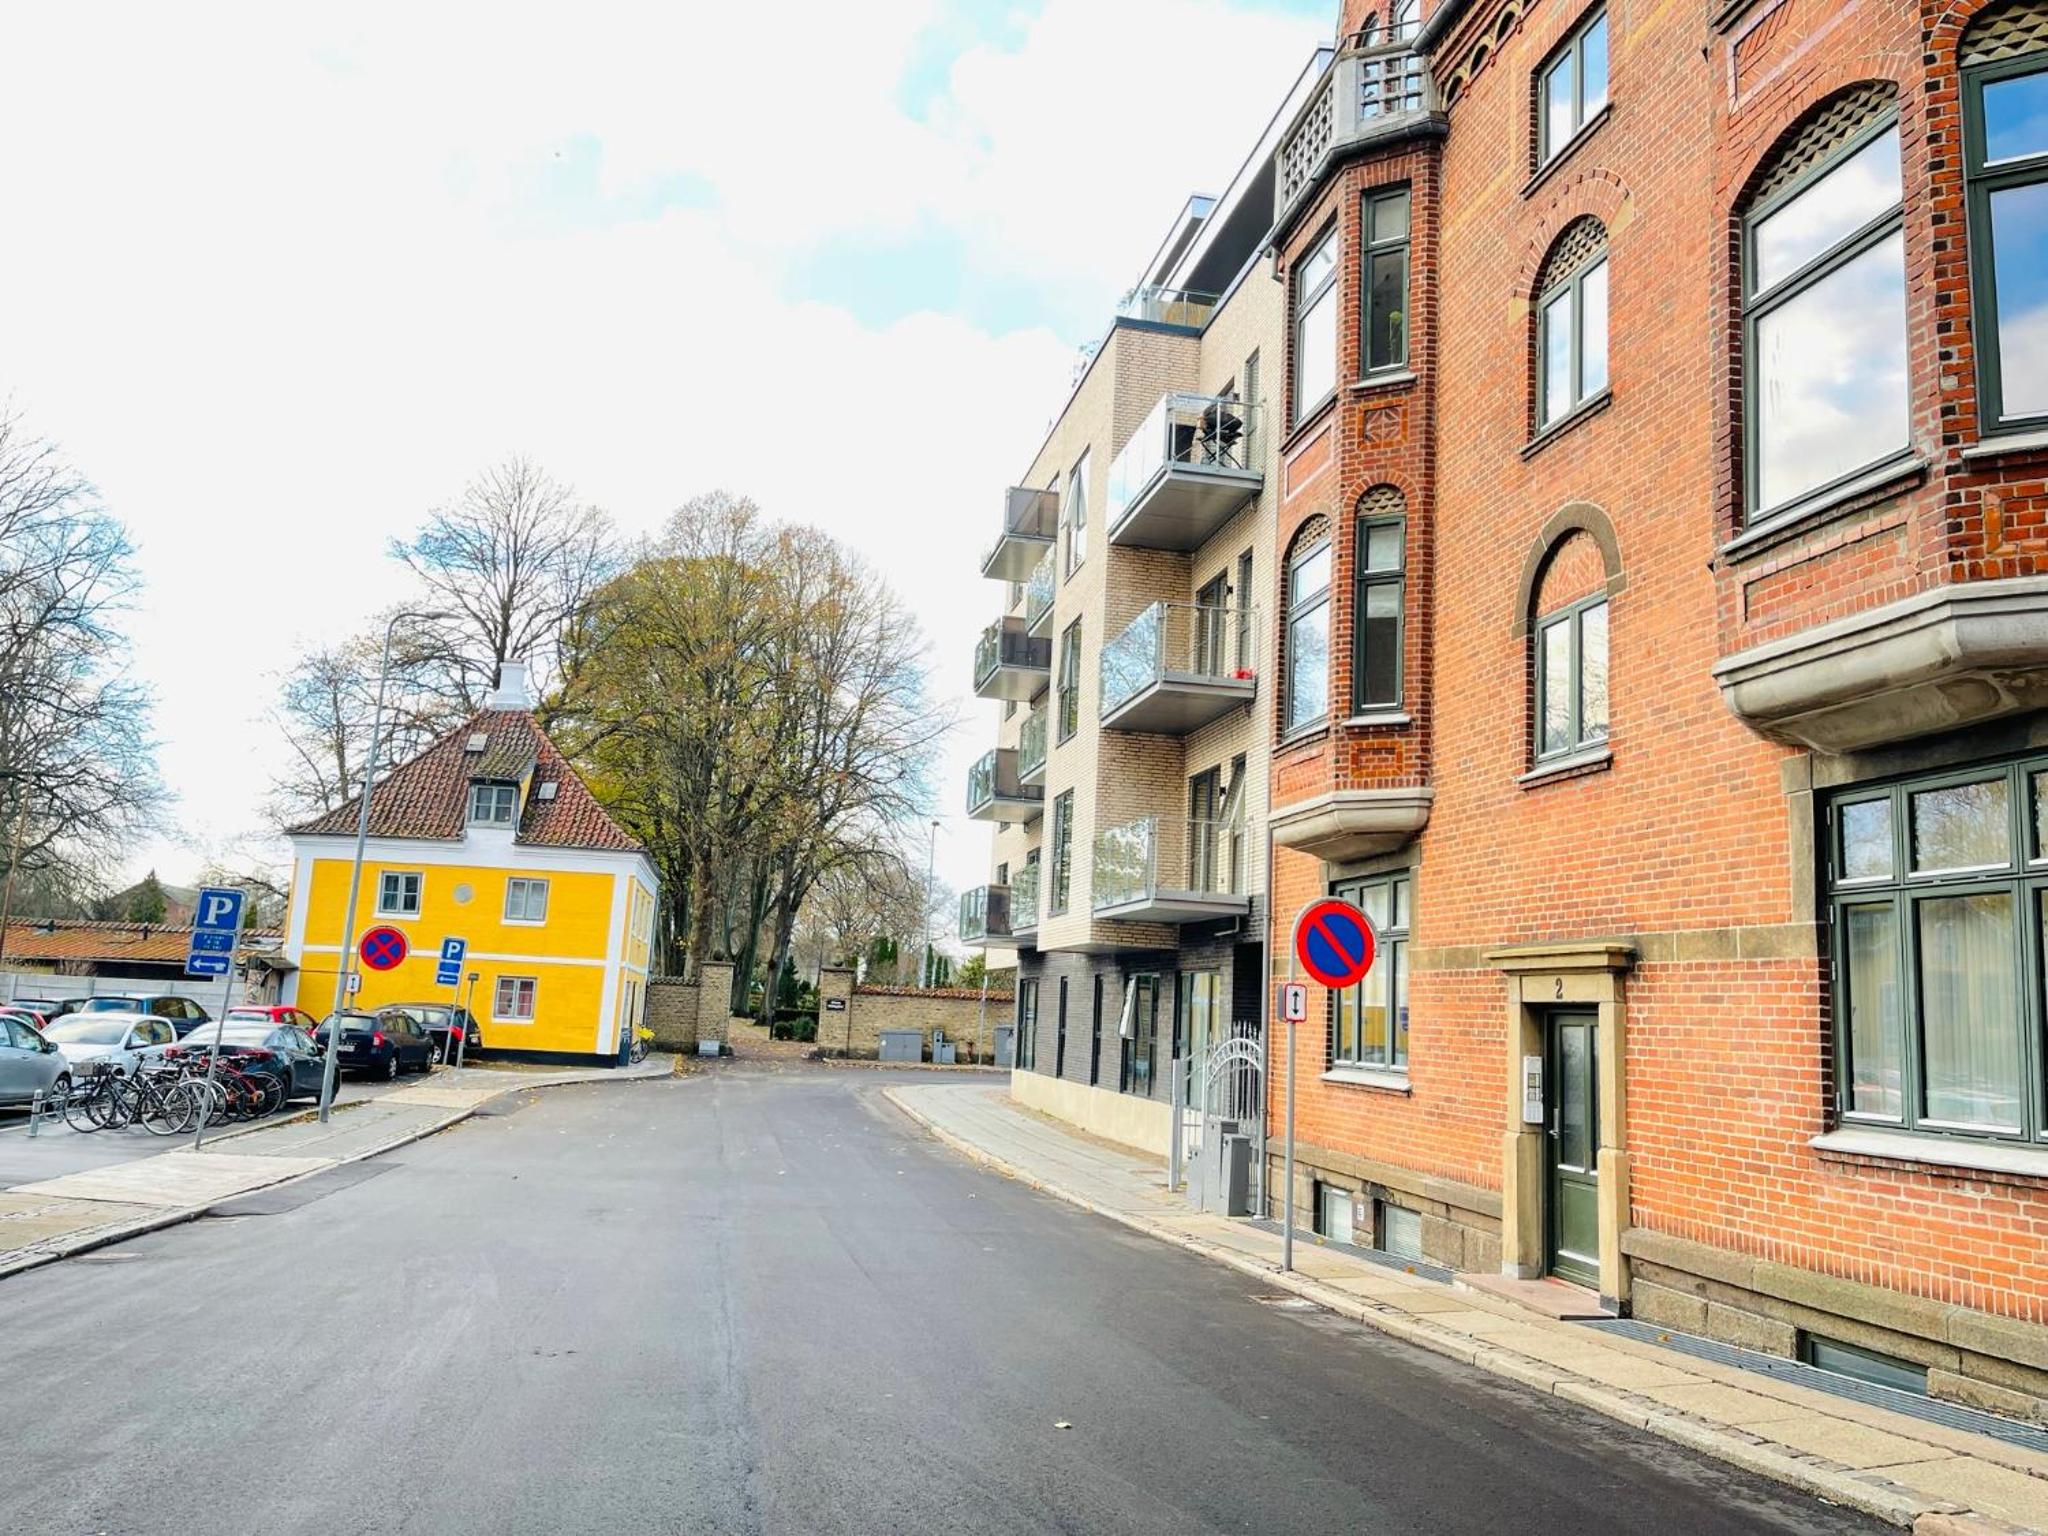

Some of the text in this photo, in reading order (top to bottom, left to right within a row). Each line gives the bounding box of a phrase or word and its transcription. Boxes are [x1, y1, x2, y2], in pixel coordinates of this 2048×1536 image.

[203, 896, 233, 924] P
[446, 941, 460, 958] P
[1555, 977, 1563, 999] 2
